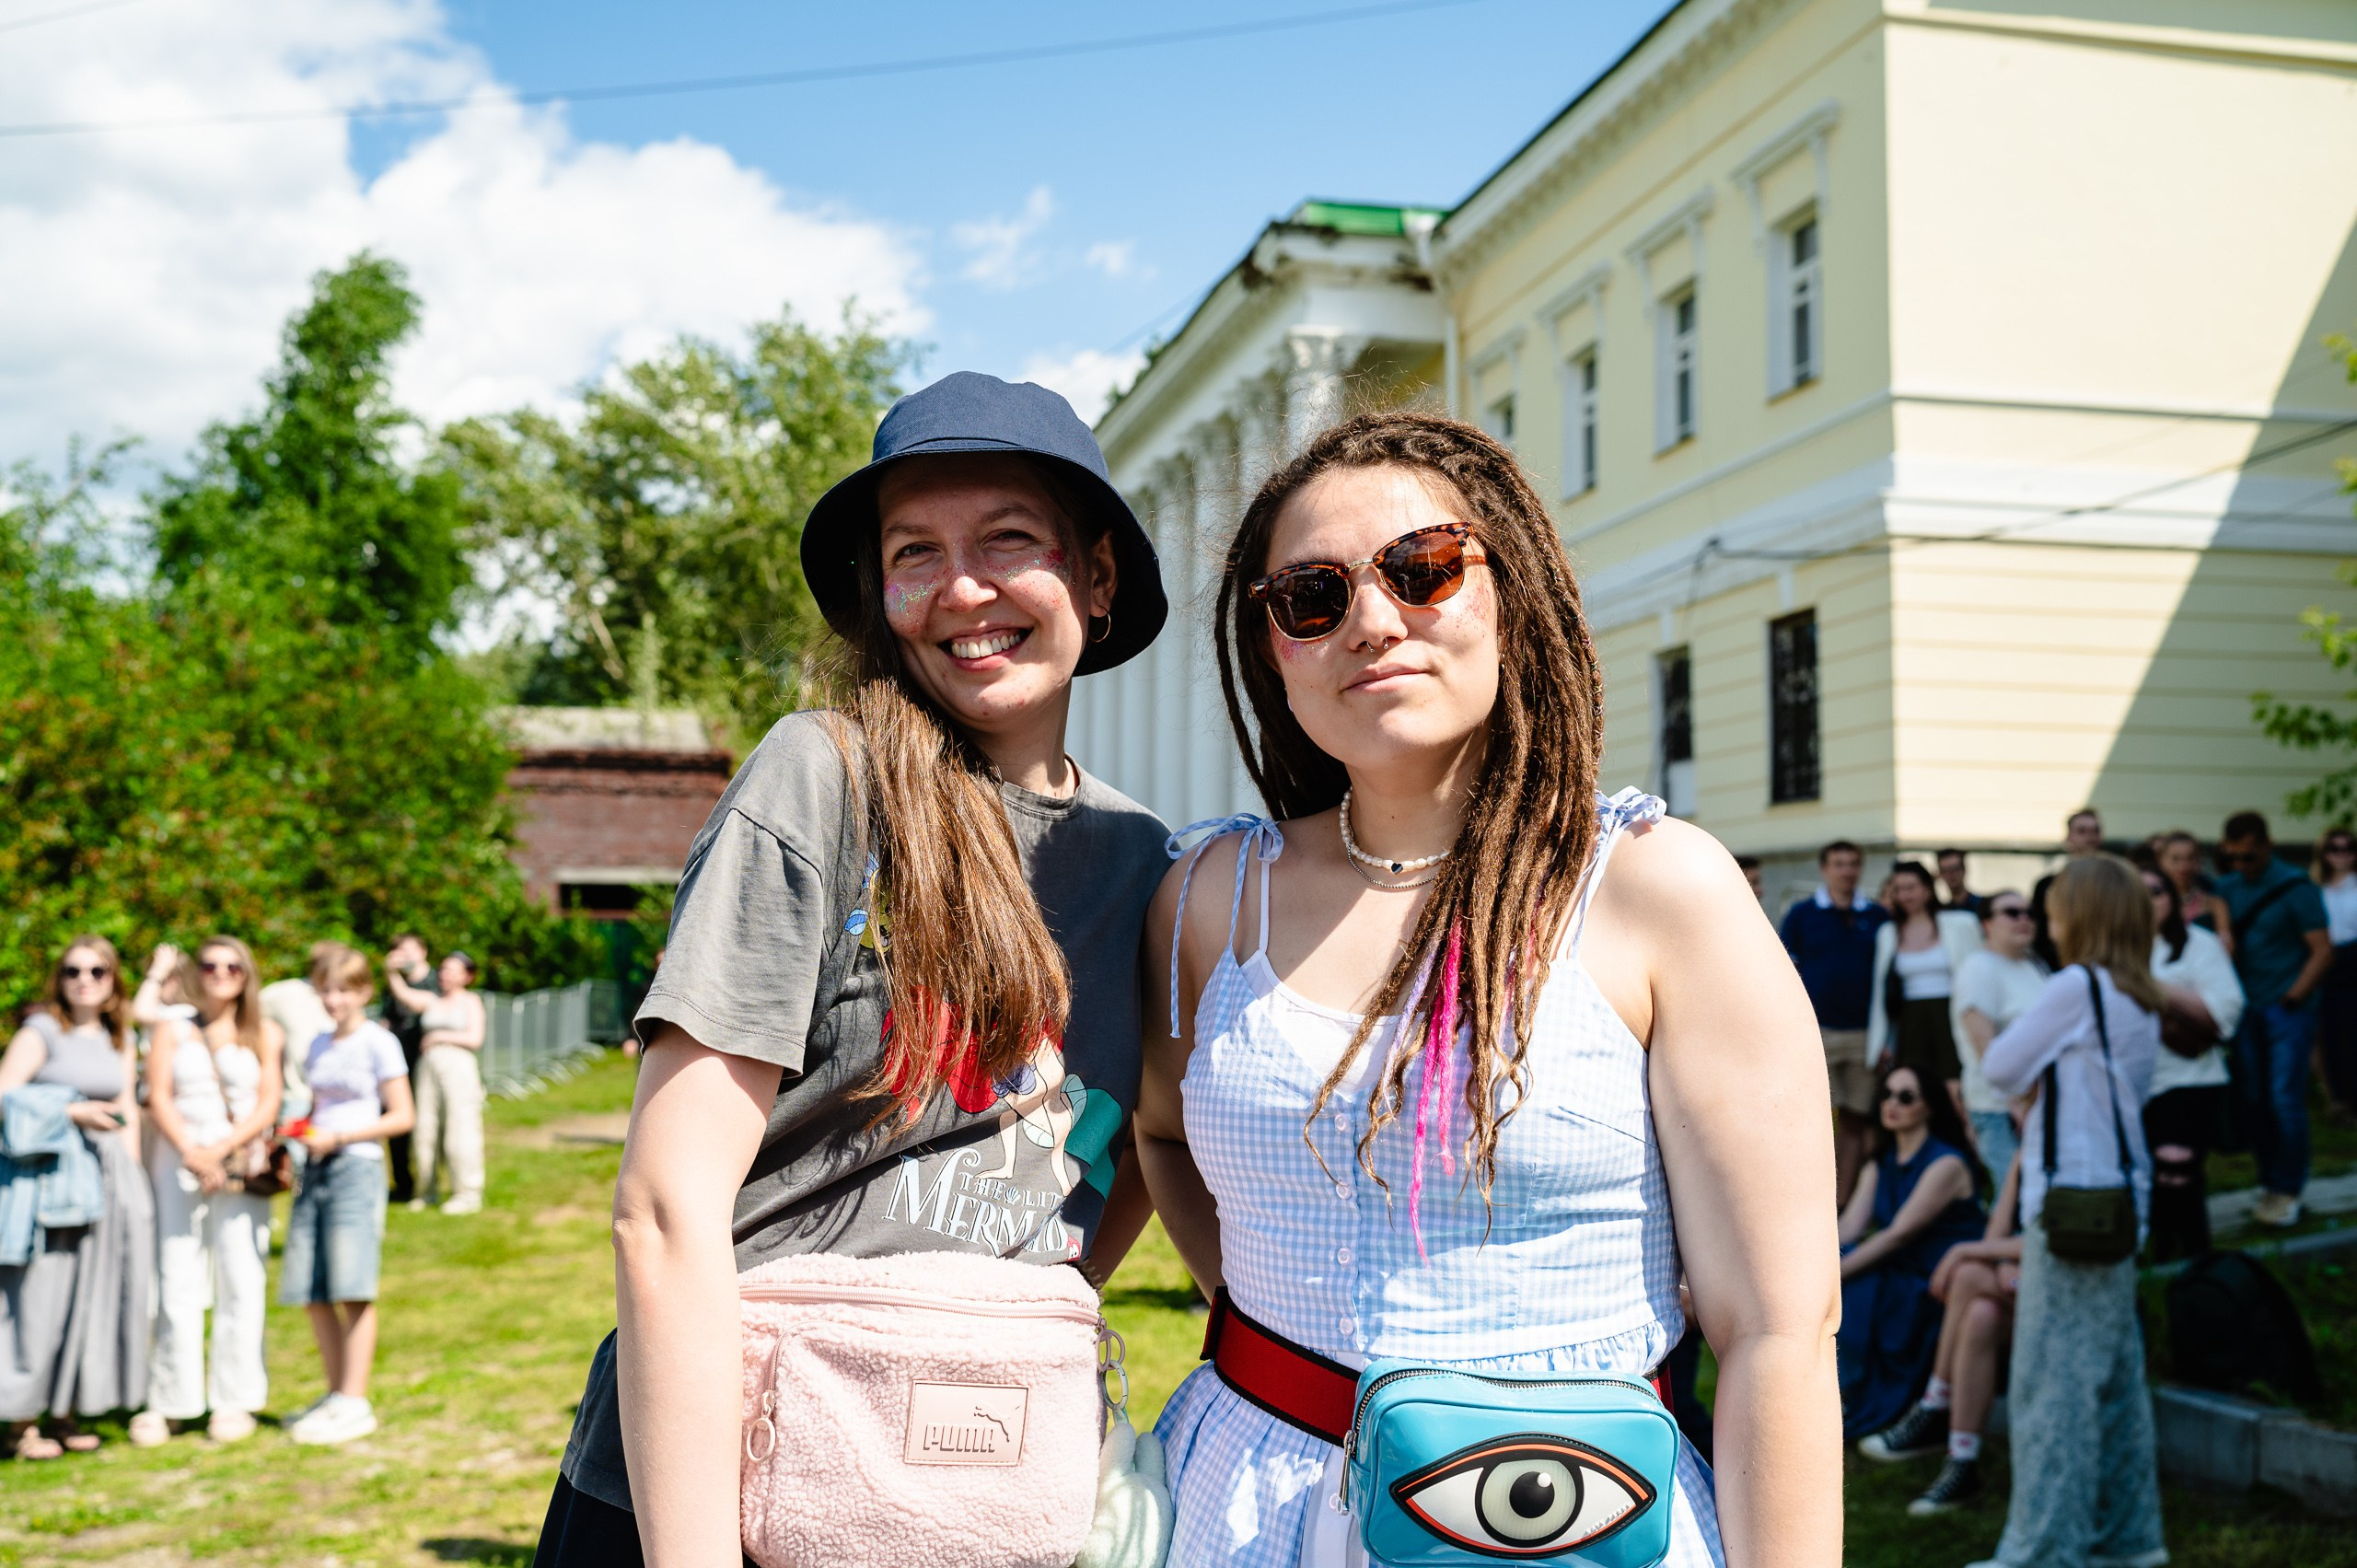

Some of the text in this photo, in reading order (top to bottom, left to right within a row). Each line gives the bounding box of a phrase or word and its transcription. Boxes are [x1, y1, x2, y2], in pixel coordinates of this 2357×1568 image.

[881, 1147, 1069, 1259] MERMD
[958, 1171, 1064, 1215] THE LIT
[923, 1423, 998, 1453] PUMA
